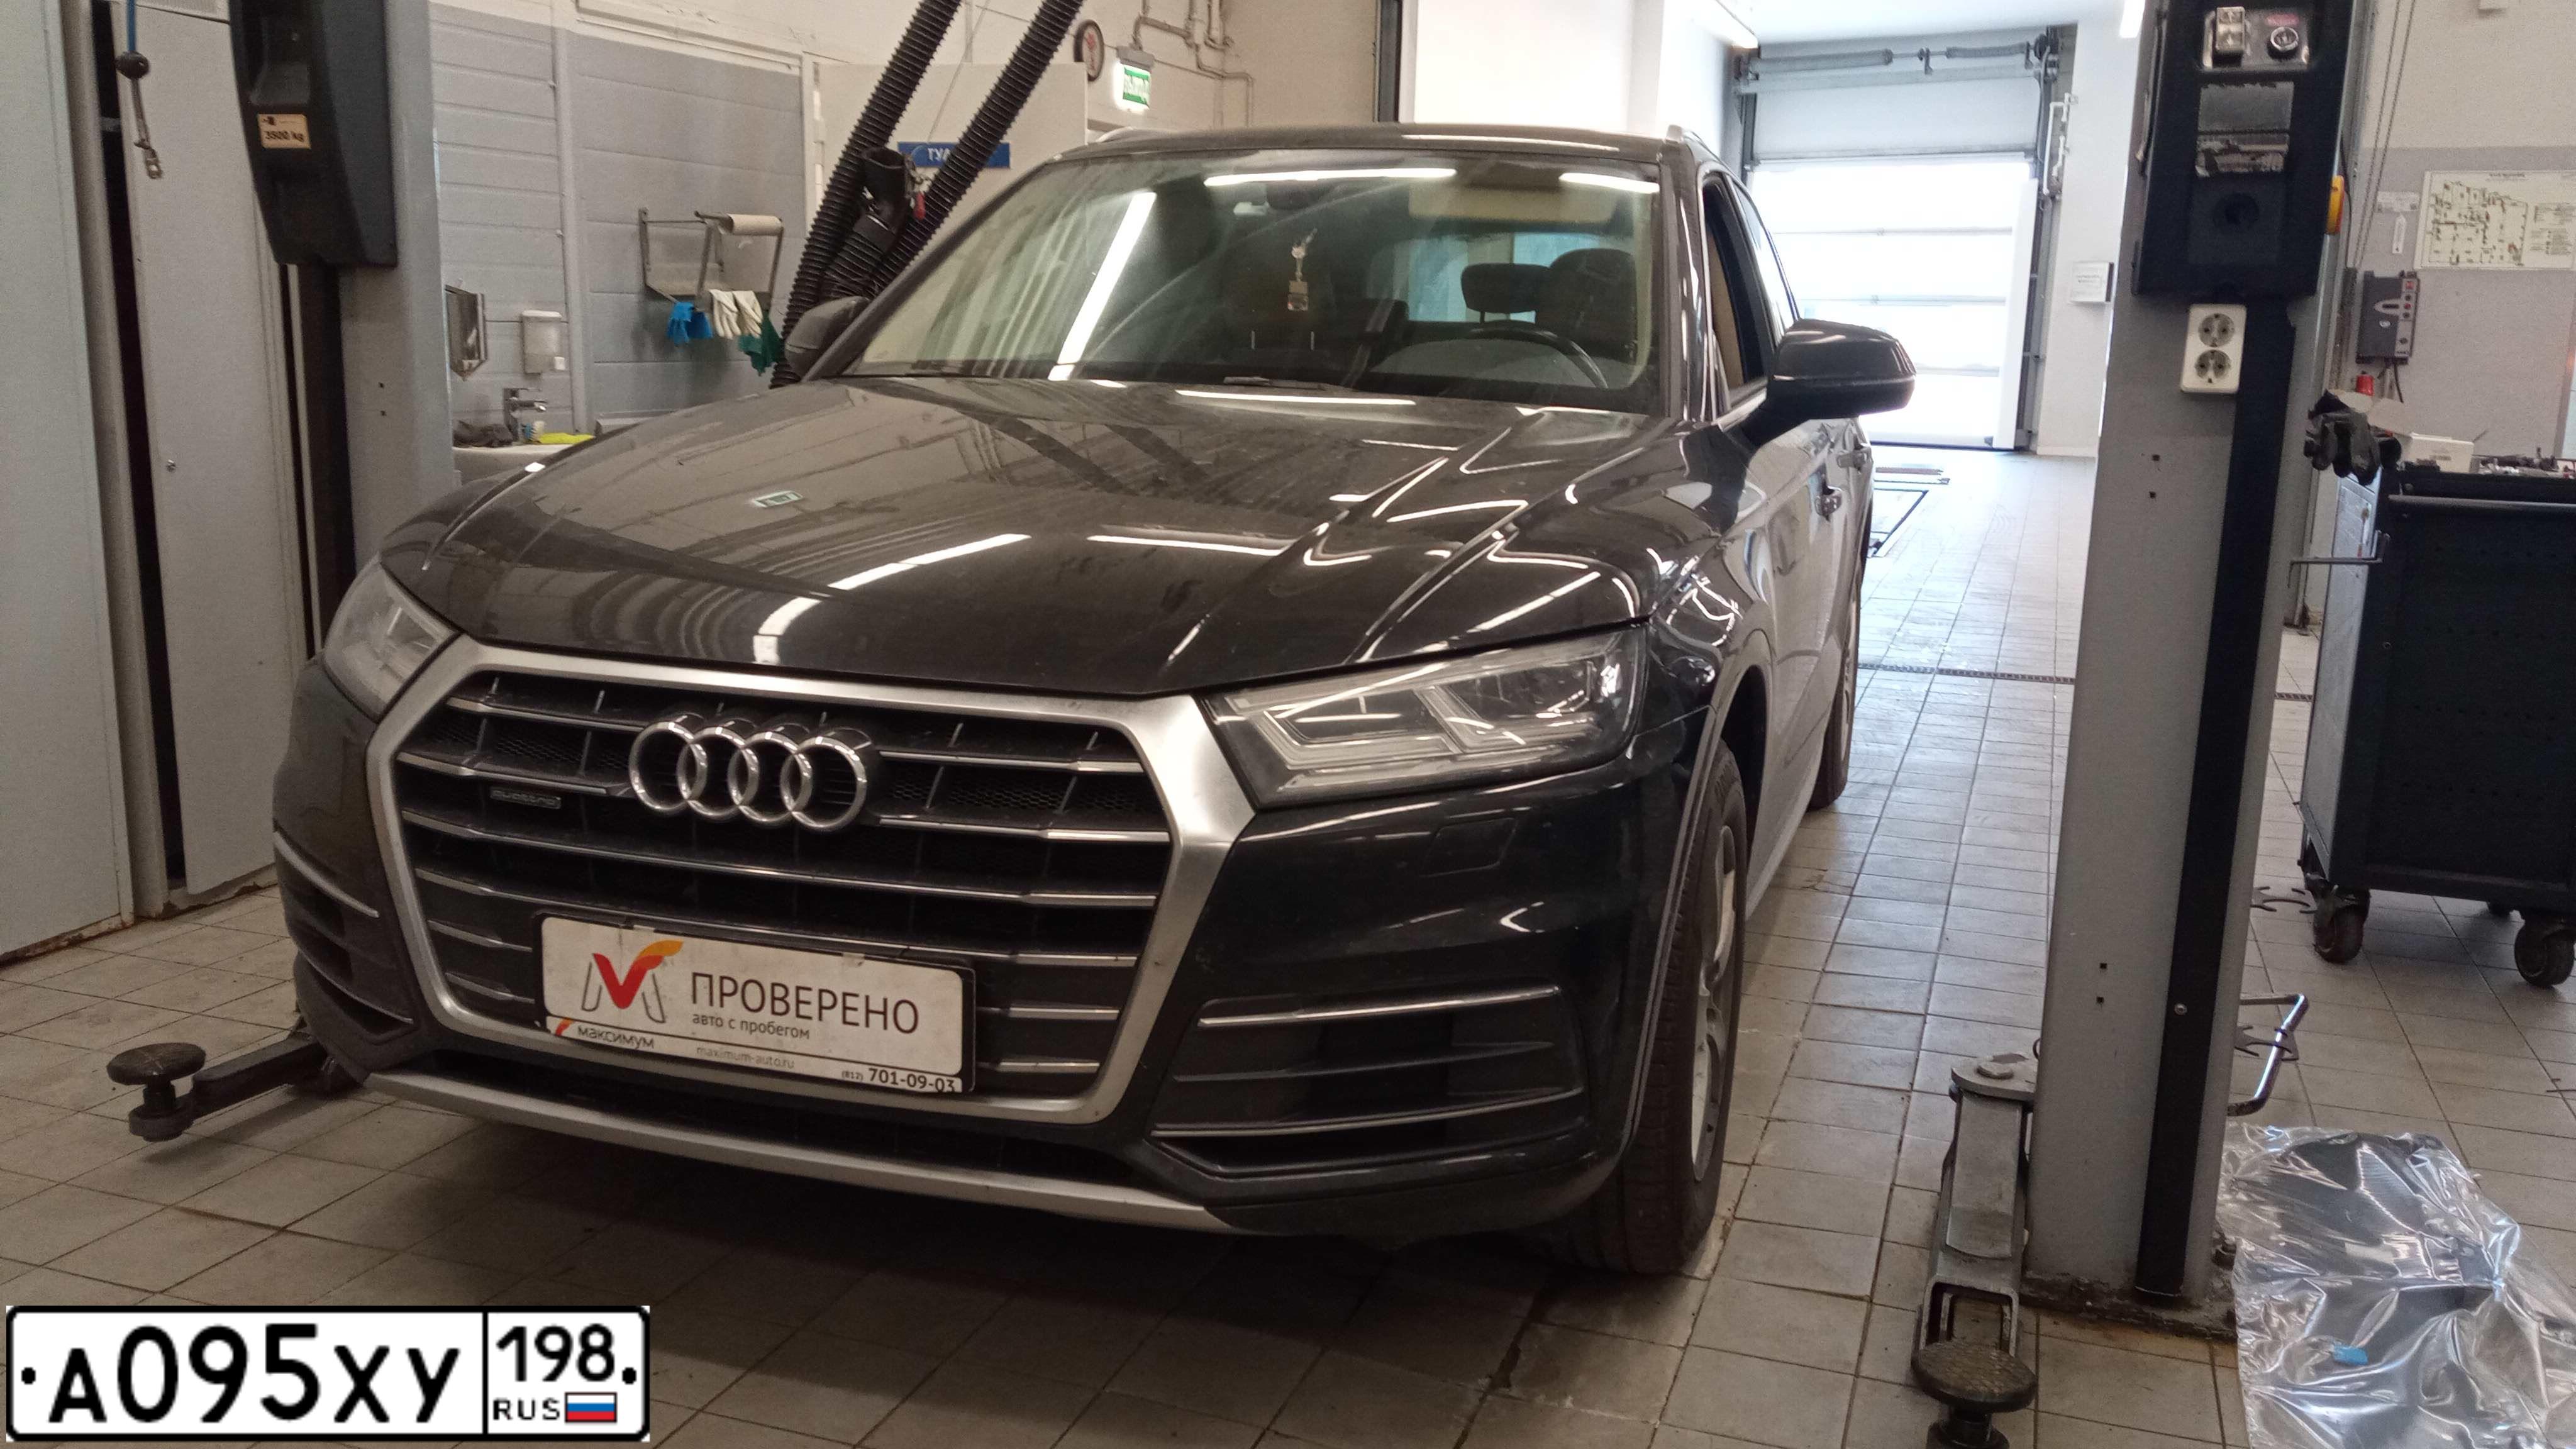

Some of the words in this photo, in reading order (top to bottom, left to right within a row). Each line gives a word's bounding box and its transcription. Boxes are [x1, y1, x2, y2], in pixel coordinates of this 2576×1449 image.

[691, 971, 919, 1035] ПРОВЕРЕНО
[577, 1026, 655, 1050] максимум
[692, 1013, 723, 1028] авто
[728, 1017, 736, 1030] с
[739, 1019, 811, 1040] пробегом
[869, 1067, 956, 1093] 701-09-03
